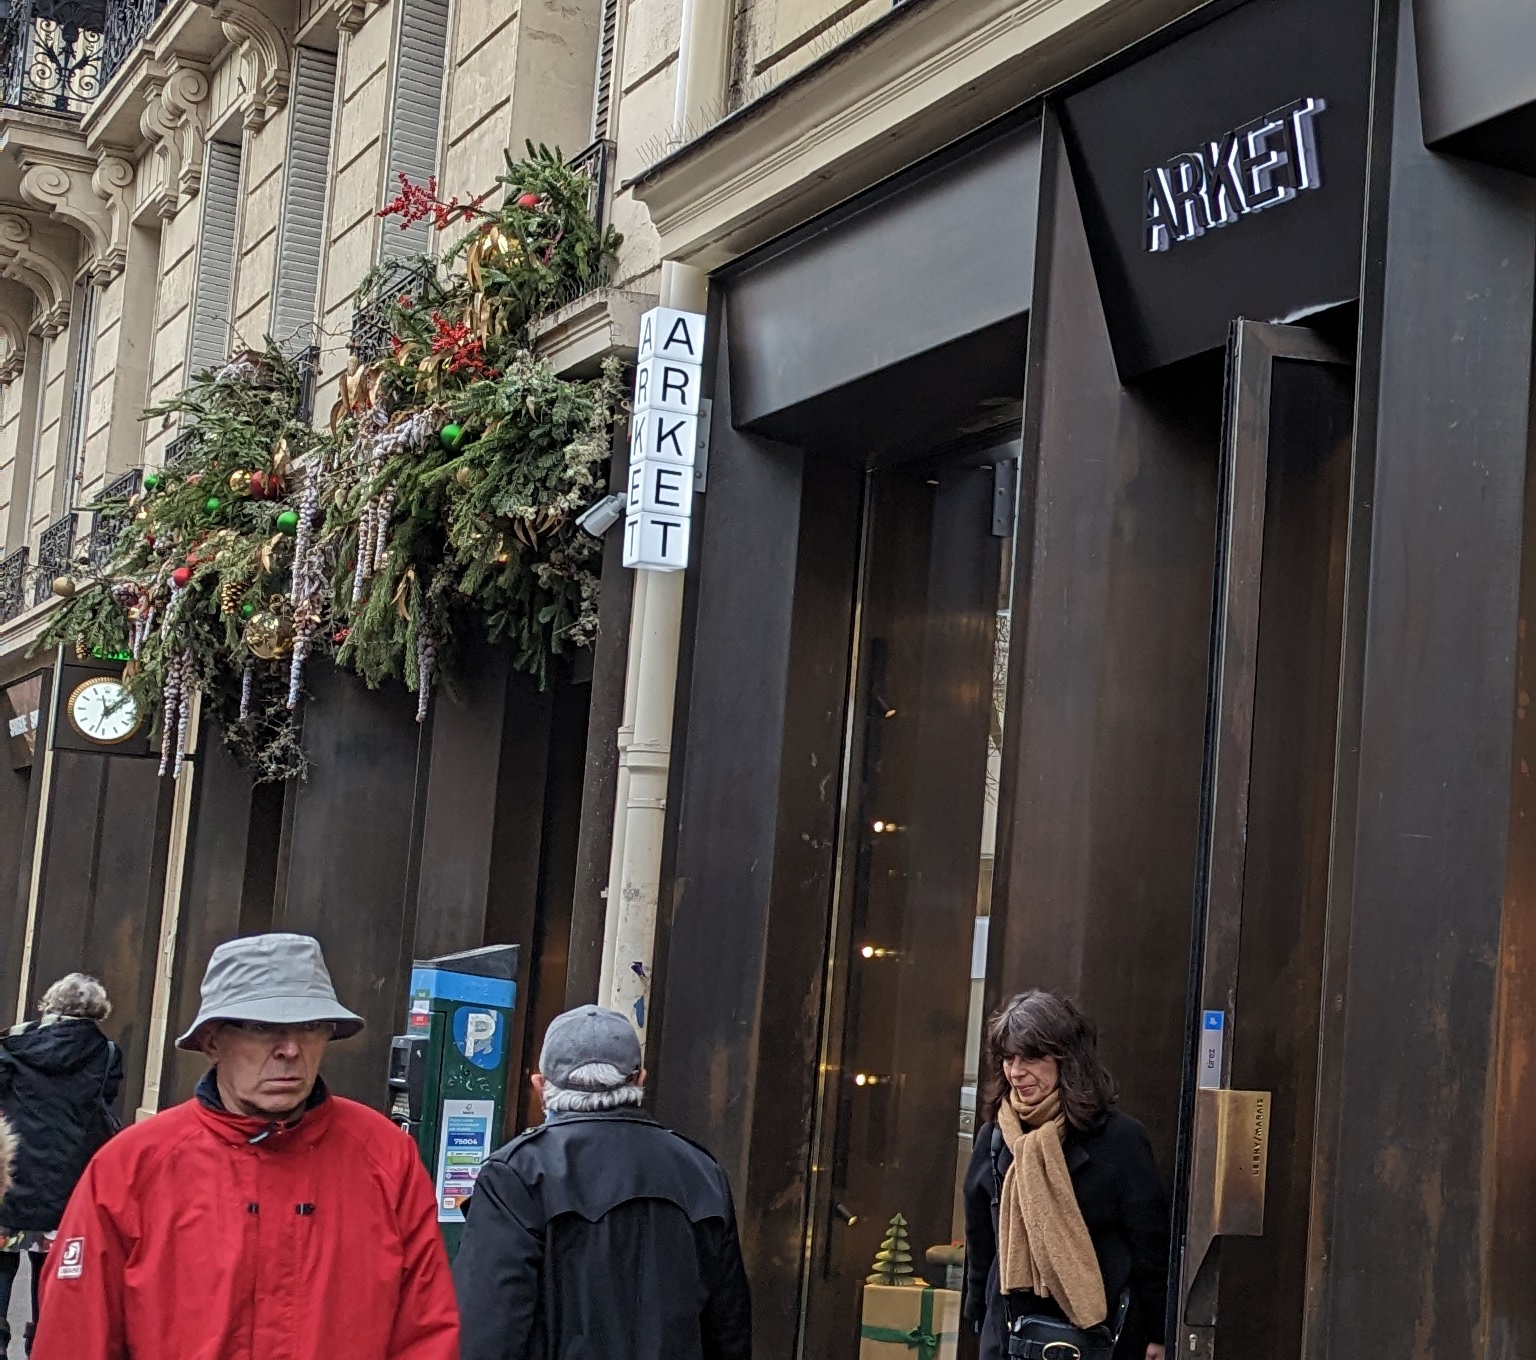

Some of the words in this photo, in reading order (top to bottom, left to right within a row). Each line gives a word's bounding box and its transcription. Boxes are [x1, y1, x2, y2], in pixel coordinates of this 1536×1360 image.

[1143, 97, 1327, 253] ARKET
[627, 316, 653, 558] ARKET
[650, 316, 695, 558] ARKET
[465, 1013, 496, 1056] P
[1207, 1048, 1216, 1069] tirez
